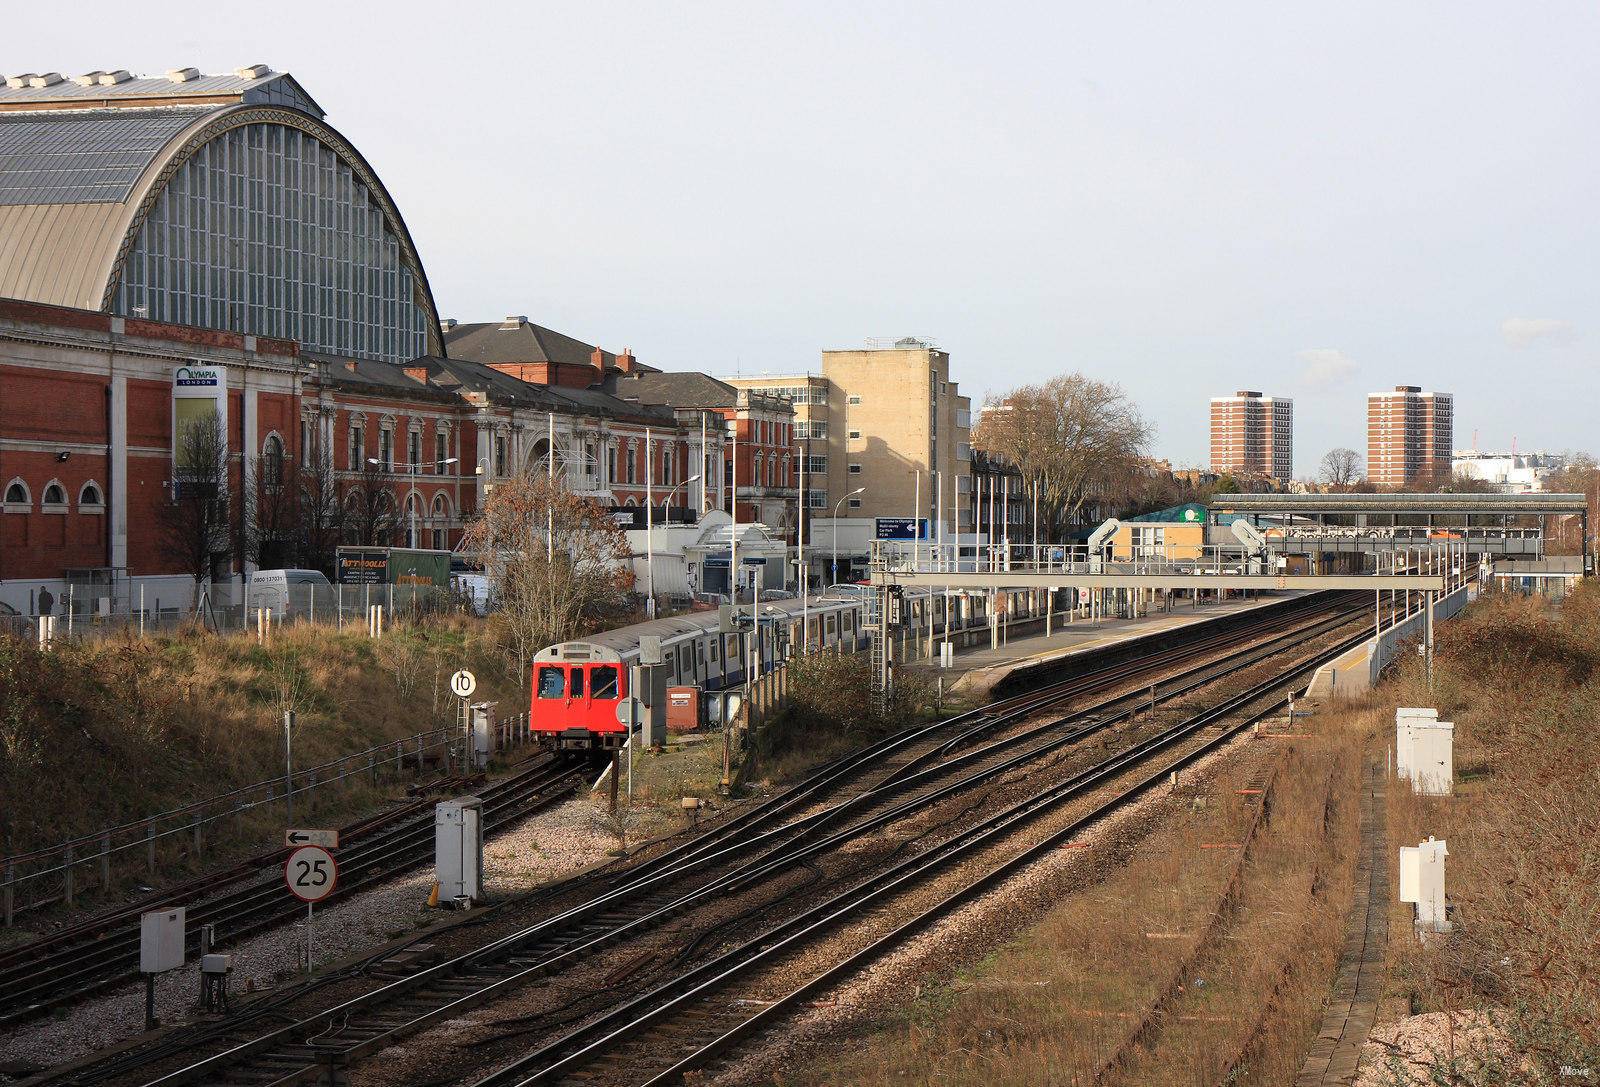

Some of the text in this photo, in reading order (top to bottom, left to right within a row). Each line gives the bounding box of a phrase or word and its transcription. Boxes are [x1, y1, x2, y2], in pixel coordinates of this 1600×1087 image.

[177, 368, 217, 378] OLYMPIA
[456, 676, 470, 691] 10
[296, 860, 328, 887] 25
